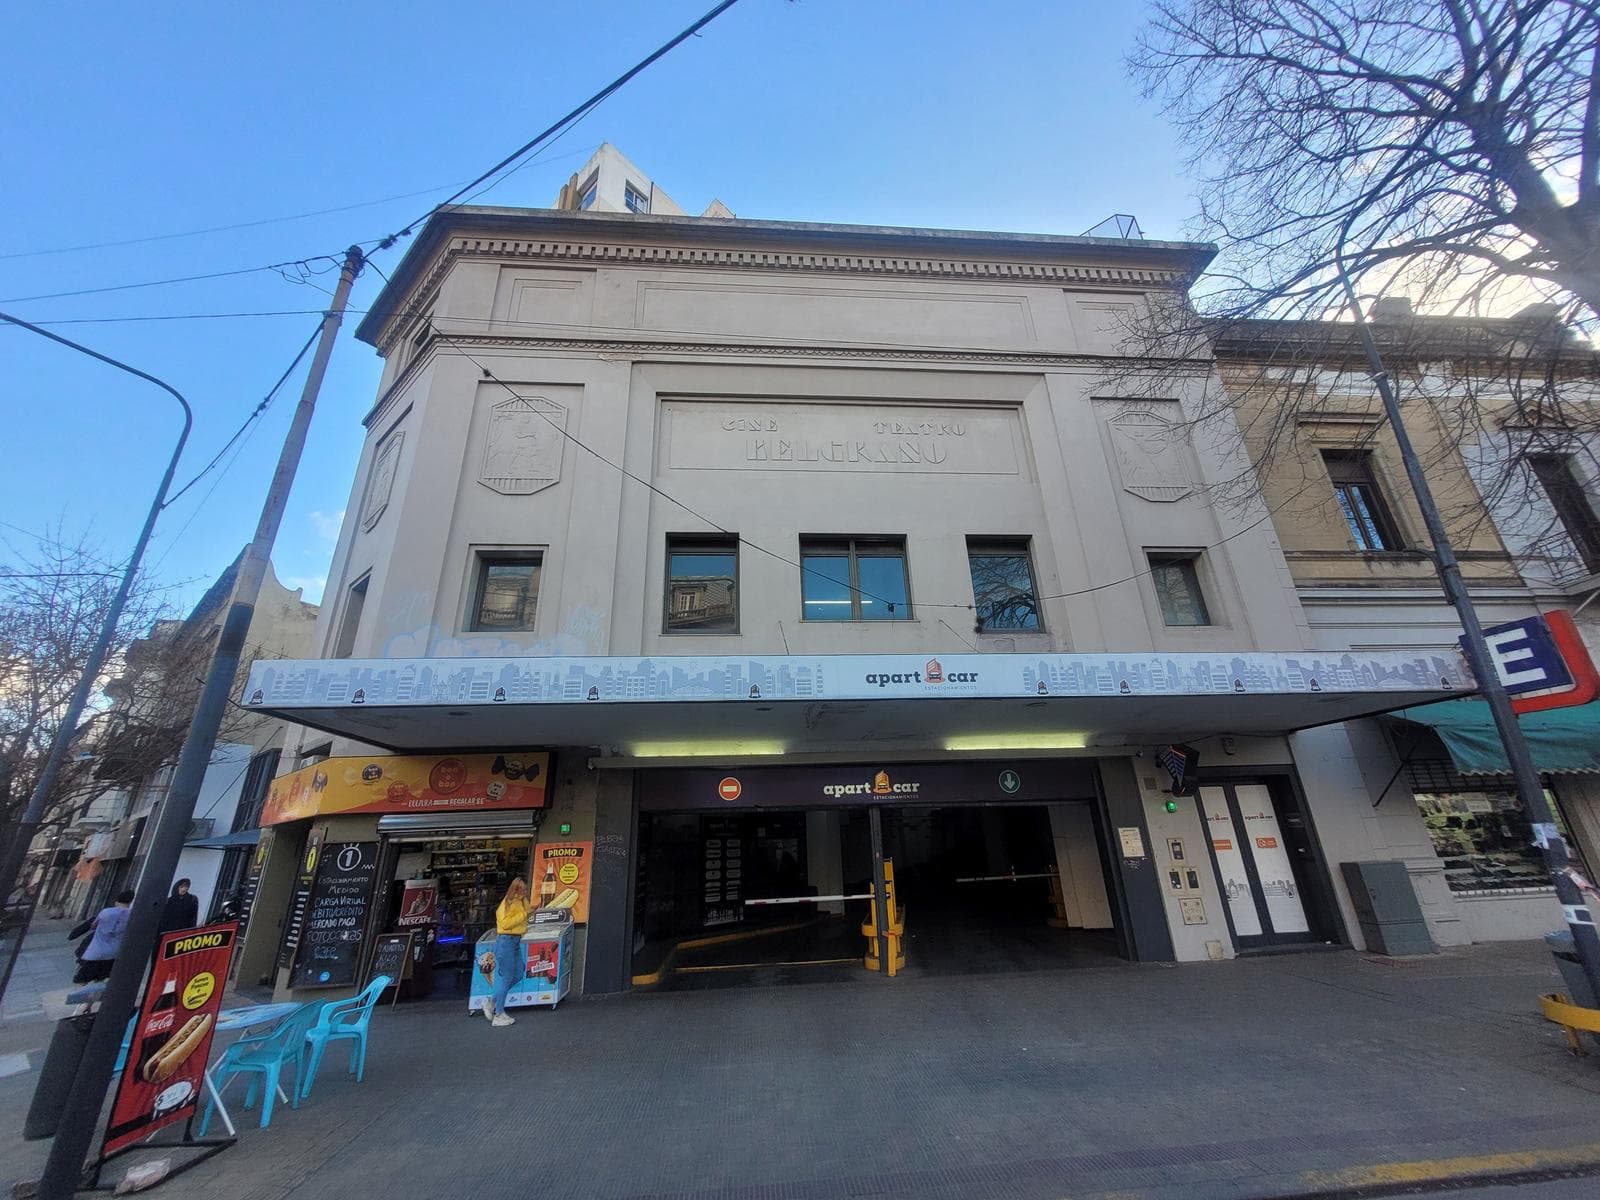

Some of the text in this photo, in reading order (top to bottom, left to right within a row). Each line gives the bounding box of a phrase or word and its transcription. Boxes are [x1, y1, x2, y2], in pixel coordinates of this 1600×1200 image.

[721, 417, 967, 436] CINE TEATRO
[746, 439, 948, 464] BELGRANO
[1484, 627, 1547, 687] E
[865, 671, 979, 687] apart car
[823, 782, 920, 798] apart car
[548, 848, 577, 858] PROMO
[174, 933, 223, 955] PROMO
